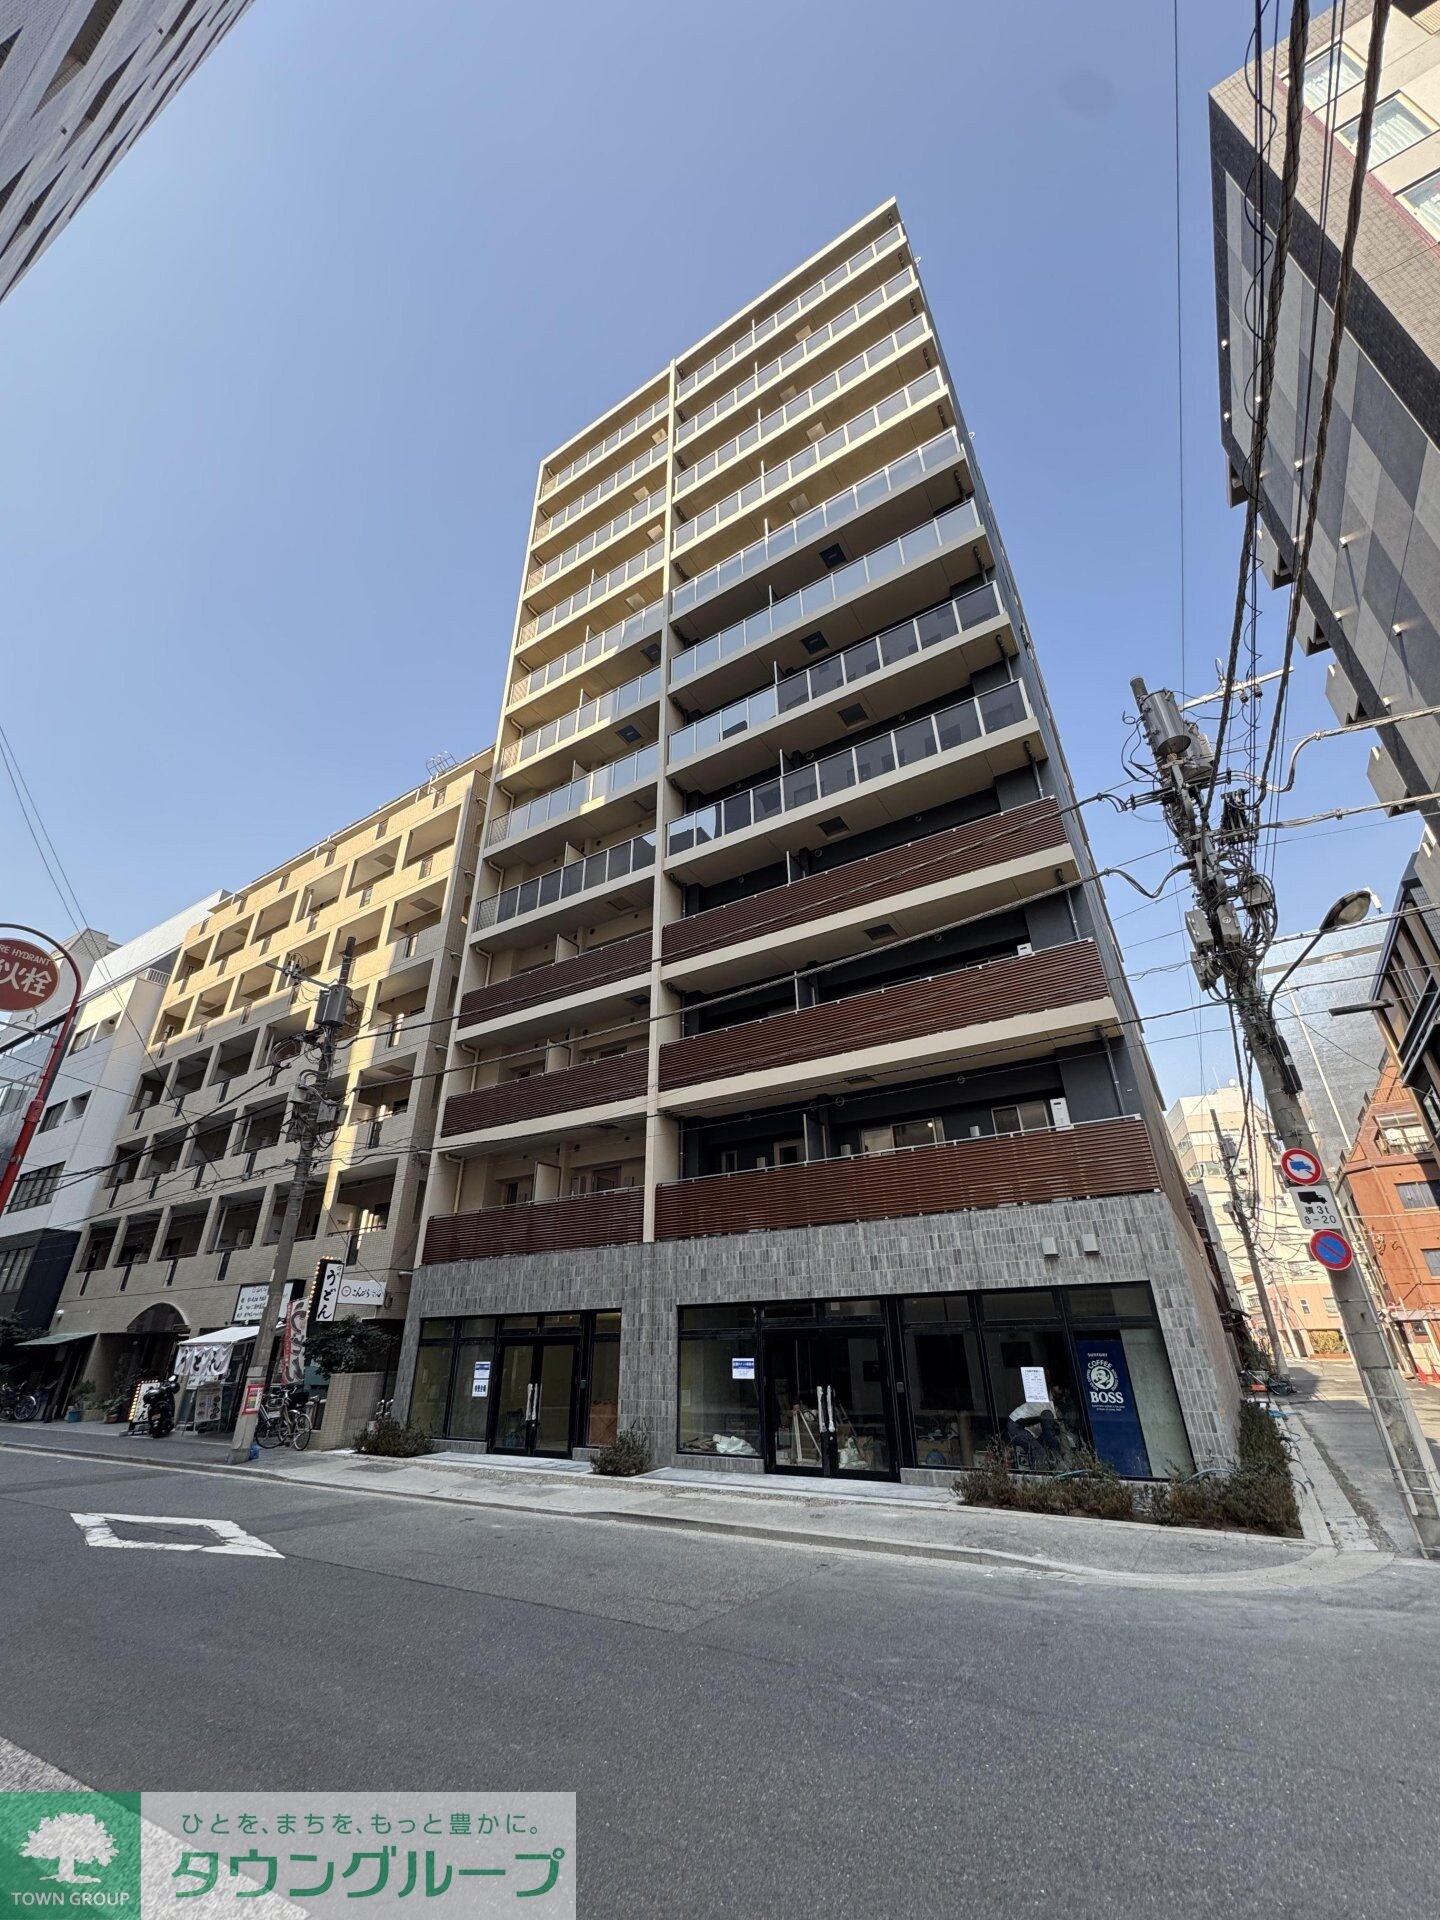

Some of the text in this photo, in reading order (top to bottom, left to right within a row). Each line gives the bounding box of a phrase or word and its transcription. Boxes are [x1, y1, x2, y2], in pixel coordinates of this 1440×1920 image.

[11, 948, 52, 966] HYDRANT
[0, 958, 52, 997] 火栓
[1304, 1215, 1337, 1225] 8-20
[317, 1269, 337, 1320] うどん
[1087, 1359, 1113, 1370] COFFEE
[1089, 1391, 1124, 1404] BOSS
